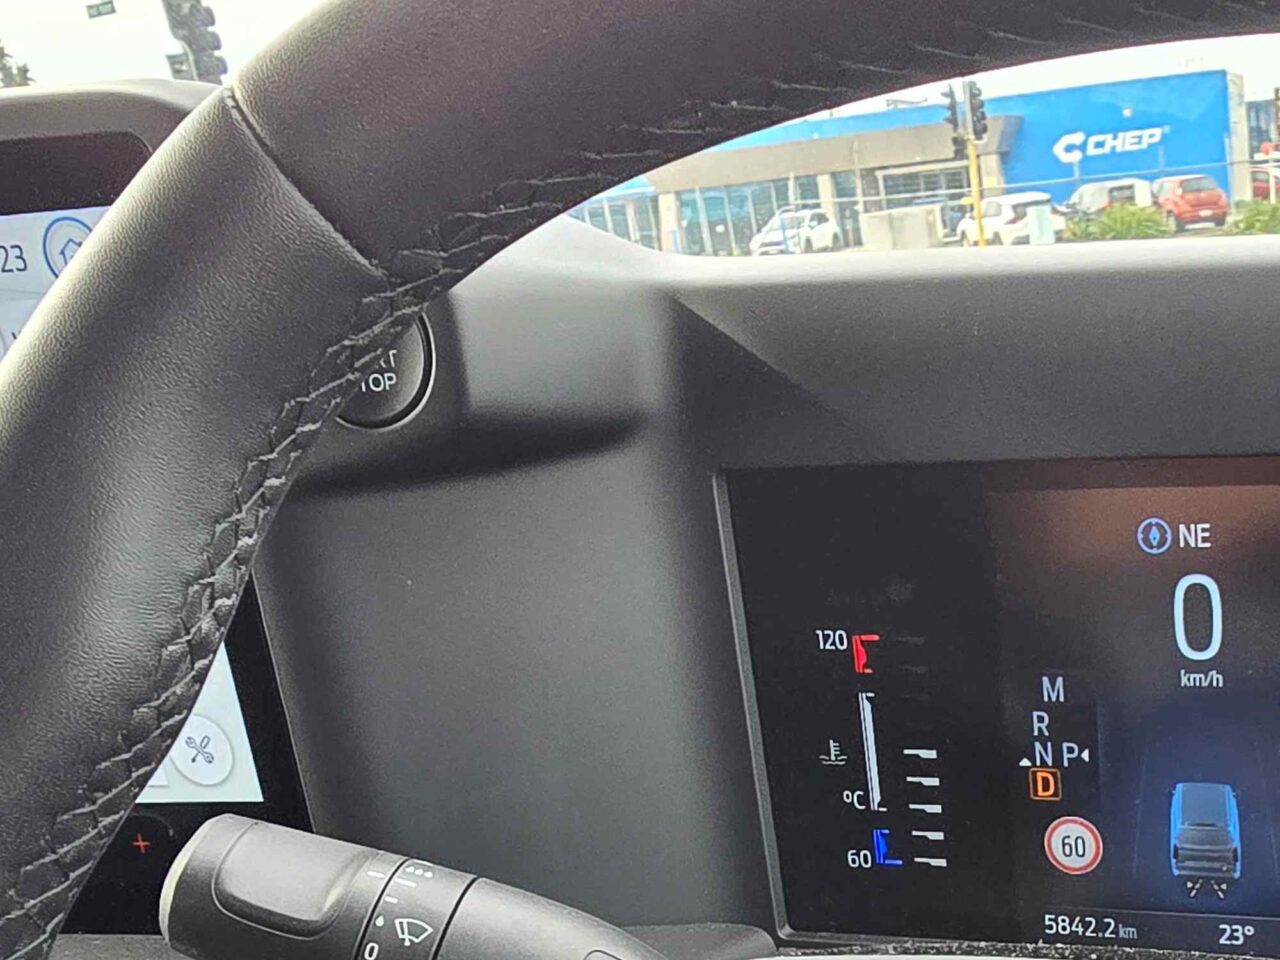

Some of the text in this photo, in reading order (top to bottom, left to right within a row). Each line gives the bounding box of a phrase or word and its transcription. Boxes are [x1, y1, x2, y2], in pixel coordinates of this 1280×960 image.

[1086, 127, 1162, 156] CHEP
[1178, 523, 1212, 548] NE
[1173, 573, 1223, 661] 0
[815, 629, 848, 651] 120
[1041, 676, 1065, 702] M
[1180, 669, 1224, 688] km/h
[1032, 711, 1049, 736] R
[1034, 741, 1079, 767] N P
[1036, 771, 1056, 796] D
[847, 849, 872, 869] 60
[1061, 835, 1086, 858] 60
[1044, 914, 1138, 940] 5842.2 km
